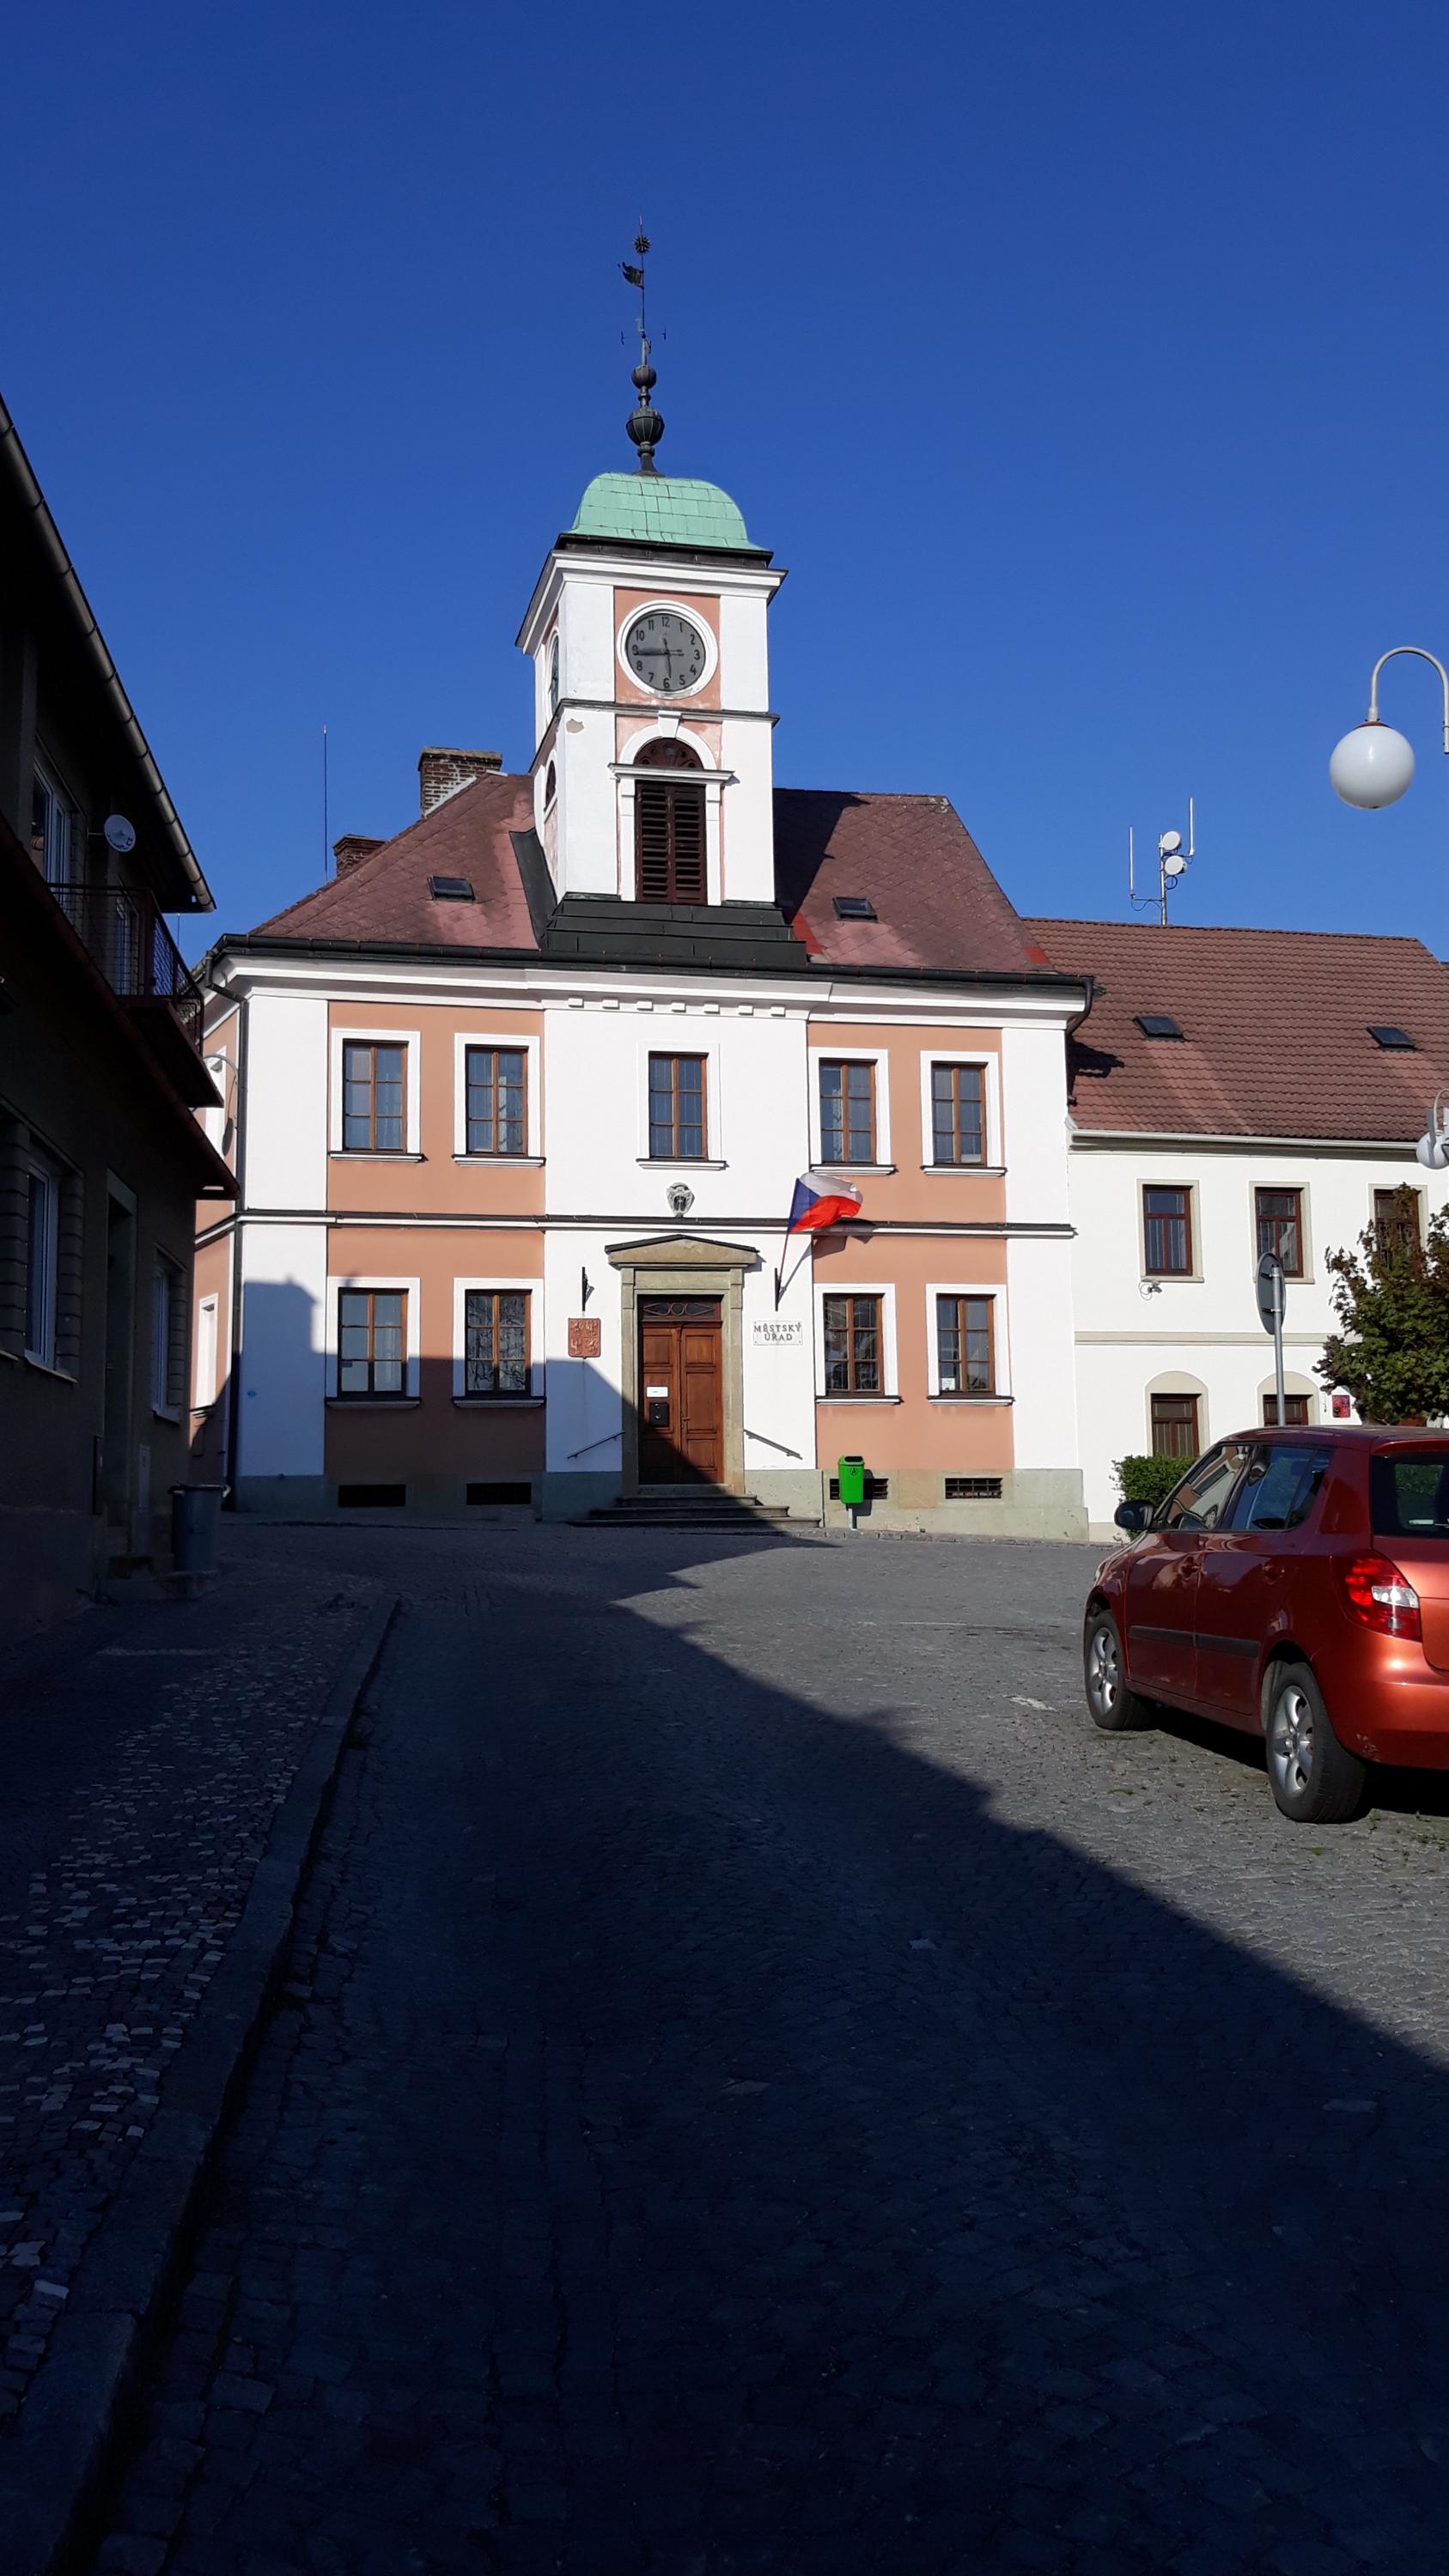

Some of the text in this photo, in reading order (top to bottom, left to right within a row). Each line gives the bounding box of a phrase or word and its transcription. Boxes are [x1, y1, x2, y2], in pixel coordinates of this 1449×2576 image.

[648, 620, 654, 631] 11
[661, 617, 670, 628] 12
[679, 622, 683, 632] 1
[636, 629, 645, 641] 10
[690, 634, 696, 645] 2
[632, 645, 639, 656] 9
[694, 649, 700, 660] 3
[636, 660, 642, 671] 8
[690, 665, 697, 675] 4
[648, 672, 654, 683] 7
[663, 677, 670, 688] 6
[679, 675, 685, 685] 5
[753, 1321, 801, 1333] MĚSTSKÝ
